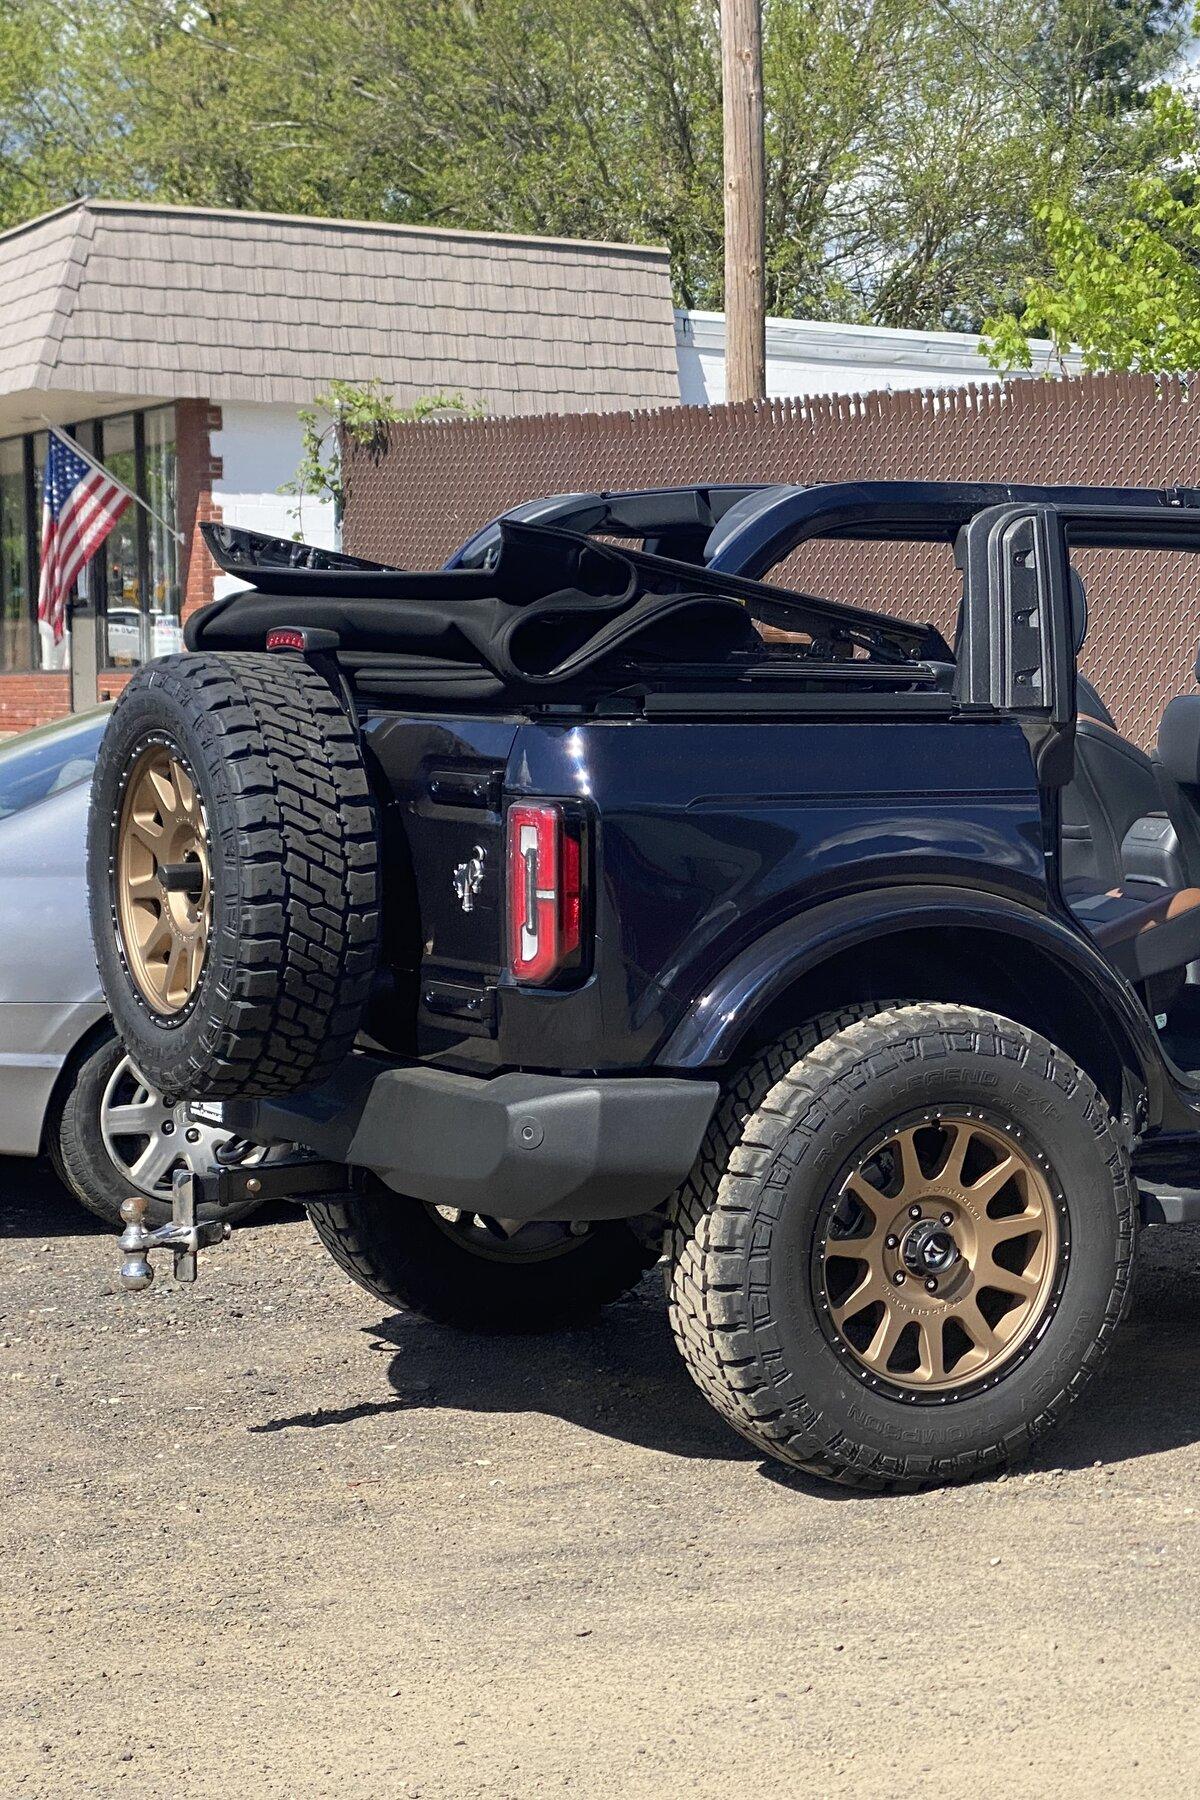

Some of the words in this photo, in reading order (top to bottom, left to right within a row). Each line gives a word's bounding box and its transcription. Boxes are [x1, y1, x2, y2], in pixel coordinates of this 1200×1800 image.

[813, 1103, 878, 1171] BAJA
[890, 1067, 999, 1099] LEGEND
[1011, 1080, 1063, 1122] EXP
[846, 1401, 1008, 1445] THOMPSON
